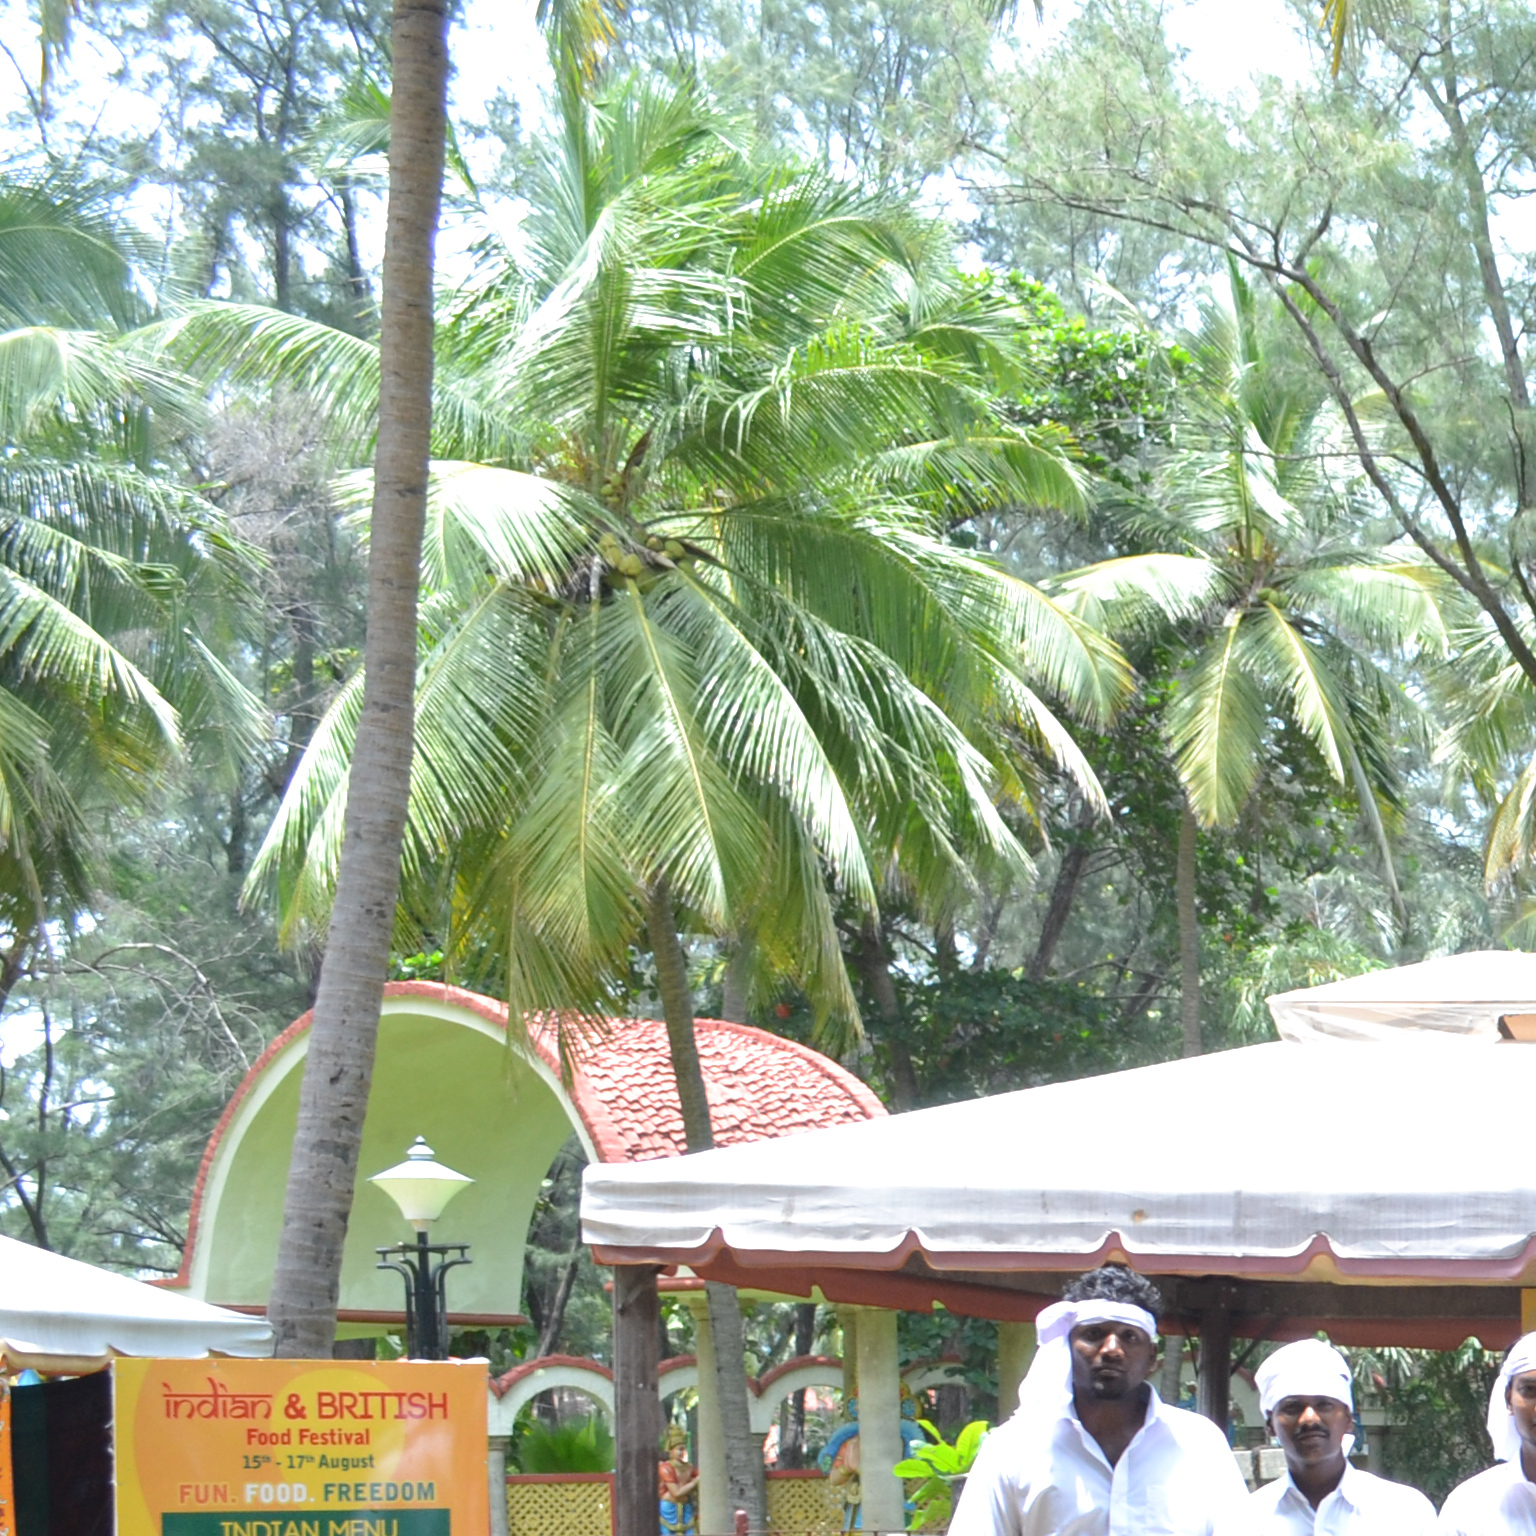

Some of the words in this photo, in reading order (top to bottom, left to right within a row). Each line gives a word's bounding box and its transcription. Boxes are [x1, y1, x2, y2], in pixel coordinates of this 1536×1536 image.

[284, 1395, 306, 1420] &
[318, 1392, 448, 1420] BRITISH
[247, 1429, 291, 1445] Food
[299, 1428, 369, 1445] Festival
[319, 1455, 375, 1471] August
[179, 1484, 236, 1504] FUN.
[244, 1483, 315, 1503] FOOD.
[324, 1482, 435, 1501] FREEDOM
